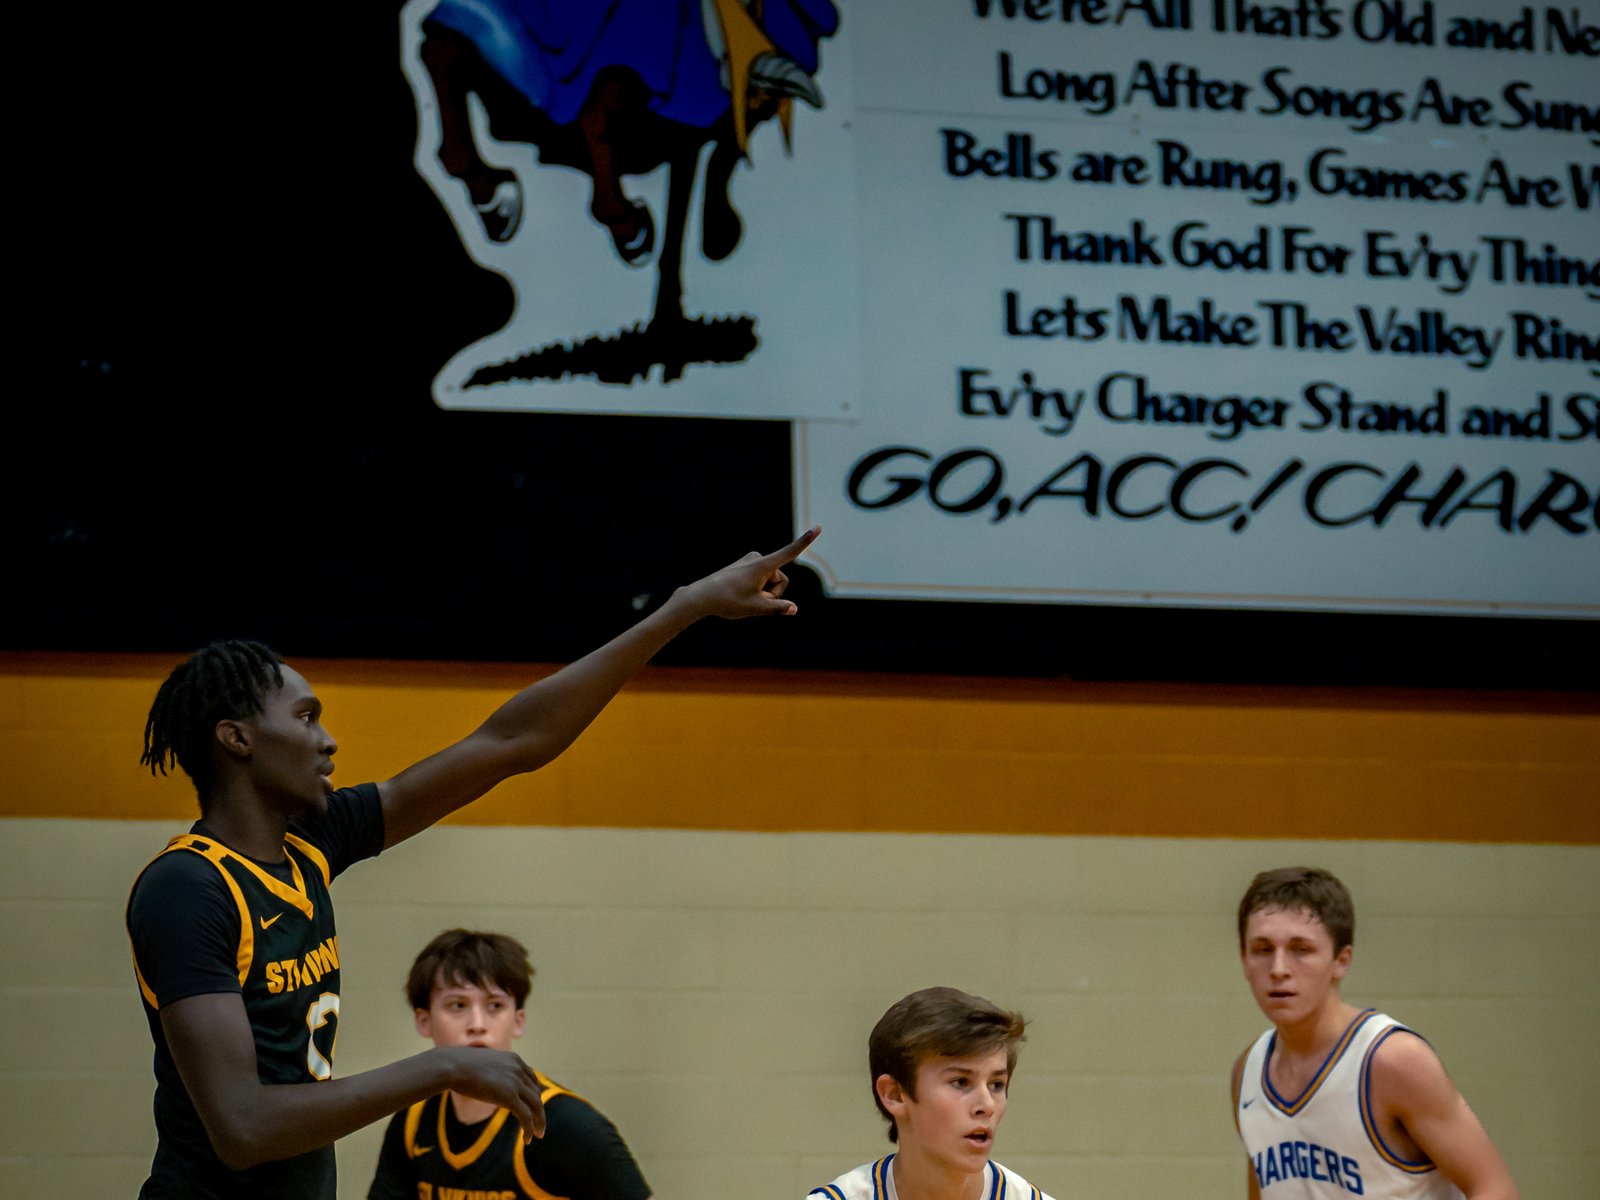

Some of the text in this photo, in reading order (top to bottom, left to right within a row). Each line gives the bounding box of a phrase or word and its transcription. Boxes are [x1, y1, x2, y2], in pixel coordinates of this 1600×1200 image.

[1113, 0, 1191, 29] All
[1353, 0, 1434, 46] Old
[1446, 7, 1534, 51] and
[997, 50, 1115, 115] Long
[1124, 60, 1252, 110] After
[1256, 66, 1404, 131] Songs
[1411, 77, 1492, 126] Are
[940, 128, 1059, 180] Bells
[1073, 152, 1149, 185] are
[1155, 138, 1298, 206] Rung,
[1308, 148, 1466, 202] Games
[1475, 158, 1564, 208] Are
[1003, 212, 1163, 265] Thank
[1172, 221, 1269, 270] God
[1283, 226, 1351, 275] For
[1366, 229, 1478, 293] Ev'ry
[1005, 289, 1108, 341] Lets
[1118, 295, 1257, 346] Make
[1257, 300, 1354, 350] The
[1356, 307, 1503, 369] Valley
[957, 366, 1085, 436] Ev'ry
[1097, 371, 1291, 440] Charger
[1300, 381, 1447, 435] Stand
[1462, 390, 1552, 439] and
[1304, 461, 1600, 536] CHAR
